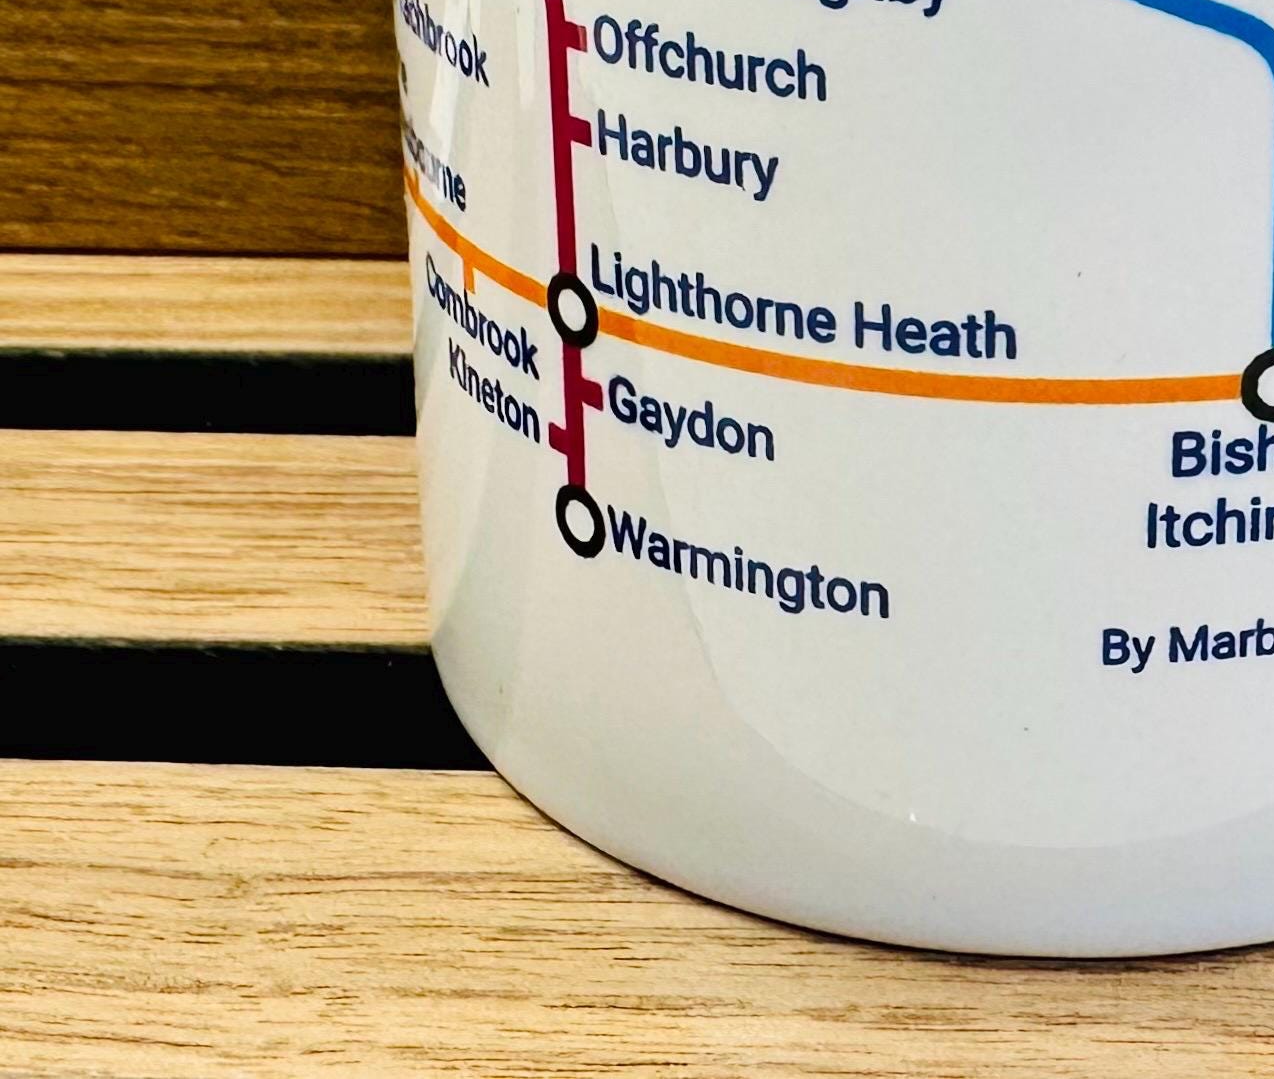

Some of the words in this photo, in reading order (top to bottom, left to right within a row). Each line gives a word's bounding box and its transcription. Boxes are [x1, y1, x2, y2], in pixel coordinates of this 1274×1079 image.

[593, 14, 827, 102] Offchurch
[597, 108, 779, 202] Harbury
[425, 252, 540, 380] Combrook
[590, 242, 837, 344] Lighthorne
[854, 301, 1017, 360] Heath
[448, 337, 541, 444] Kineton
[608, 374, 775, 462] Gaydon
[607, 504, 890, 619] Warmington
[1102, 627, 1156, 674] By
